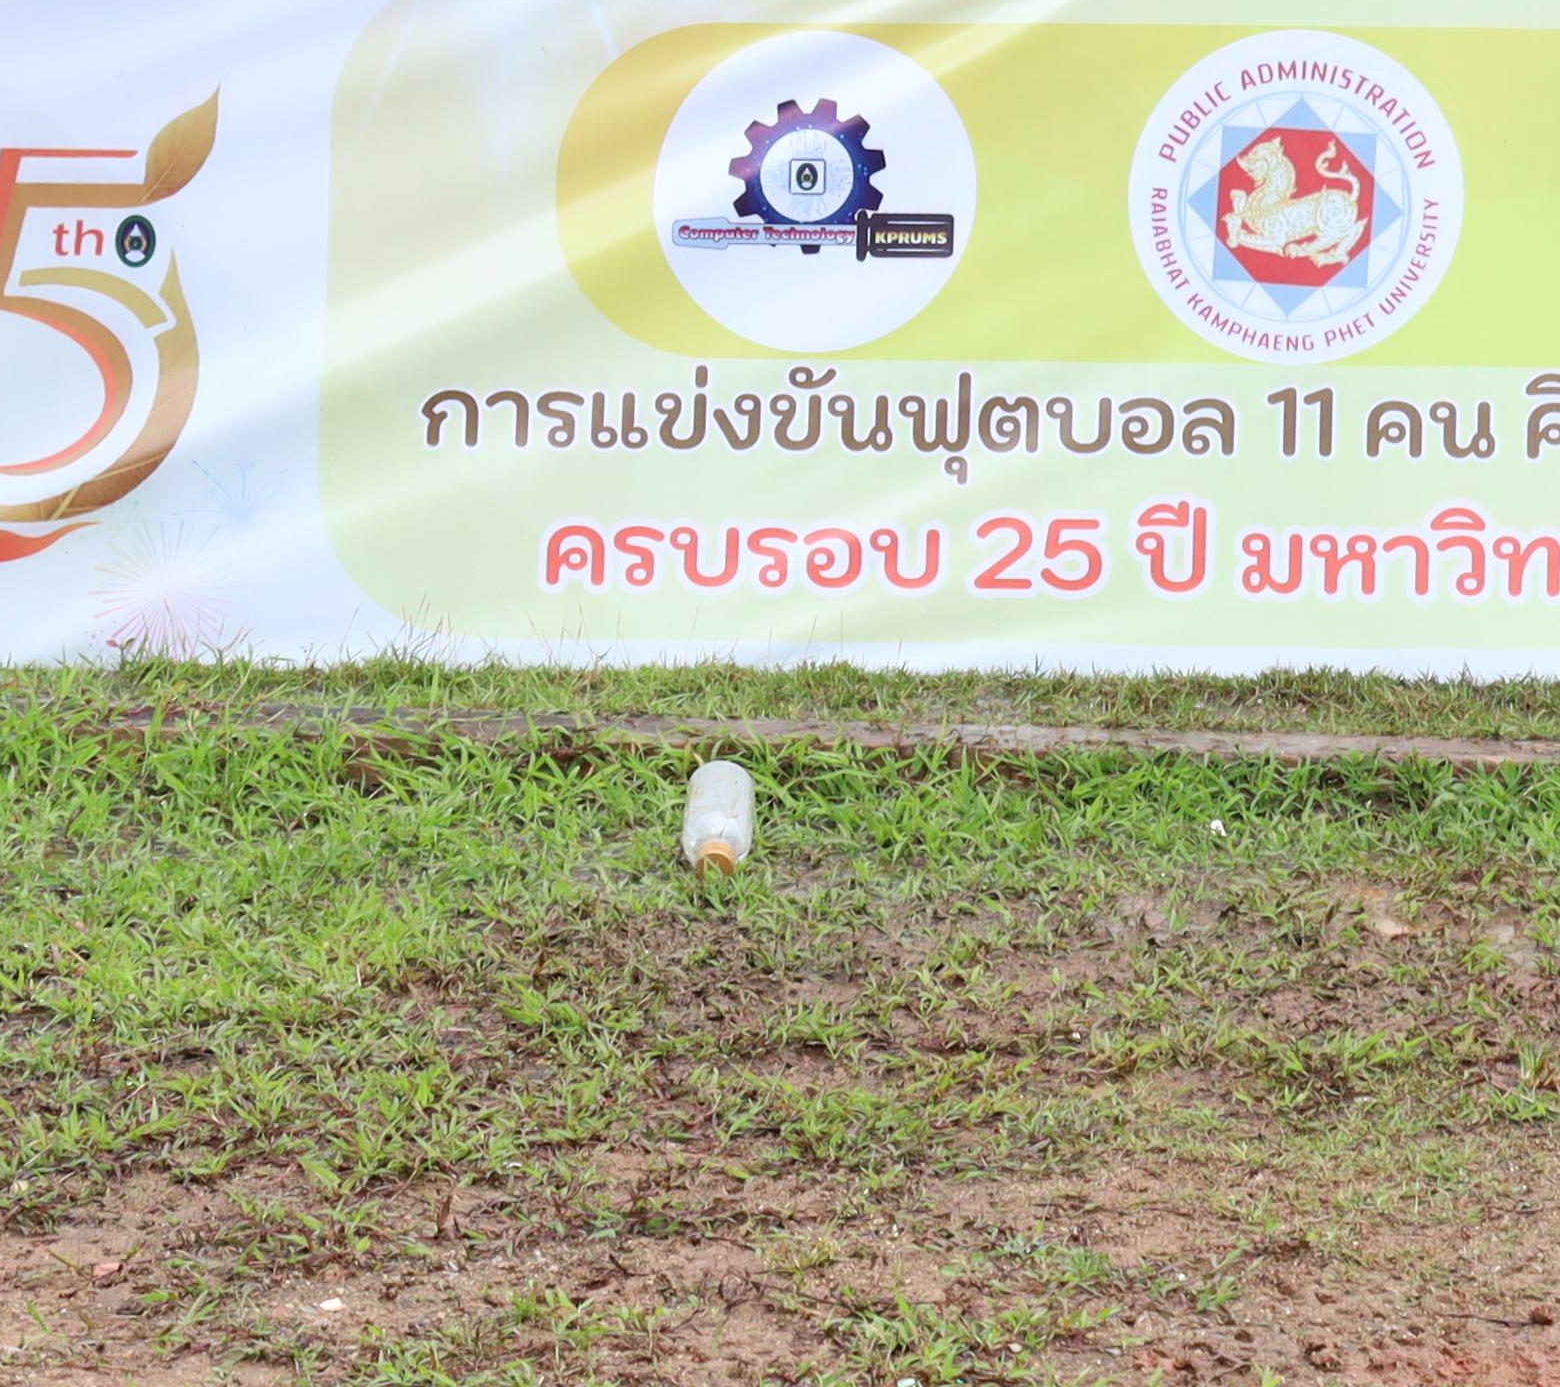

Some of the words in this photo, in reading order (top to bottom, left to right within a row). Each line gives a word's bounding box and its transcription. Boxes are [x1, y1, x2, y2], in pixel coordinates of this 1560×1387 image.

[1158, 80, 1233, 163] PUBLIC
[1240, 60, 1437, 170] ADMINISTRATION
[52, 219, 104, 257] th
[678, 225, 760, 244] Computer
[764, 225, 856, 247] Technology
[874, 230, 949, 246] KPRUMS
[1150, 187, 1191, 291] RAJABHAT
[1186, 292, 1315, 352] KAMPHAENG
[1324, 312, 1377, 348] PHET
[1379, 198, 1440, 316] UNIVERSITY
[420, 365, 1236, 484] การแข่งขันฟุตบอล
[1267, 386, 1332, 457] 11
[1366, 399, 1495, 461] คน
[545, 521, 940, 591] ครบรอบ
[974, 516, 1103, 591] 25
[1136, 499, 1208, 593] ปี
